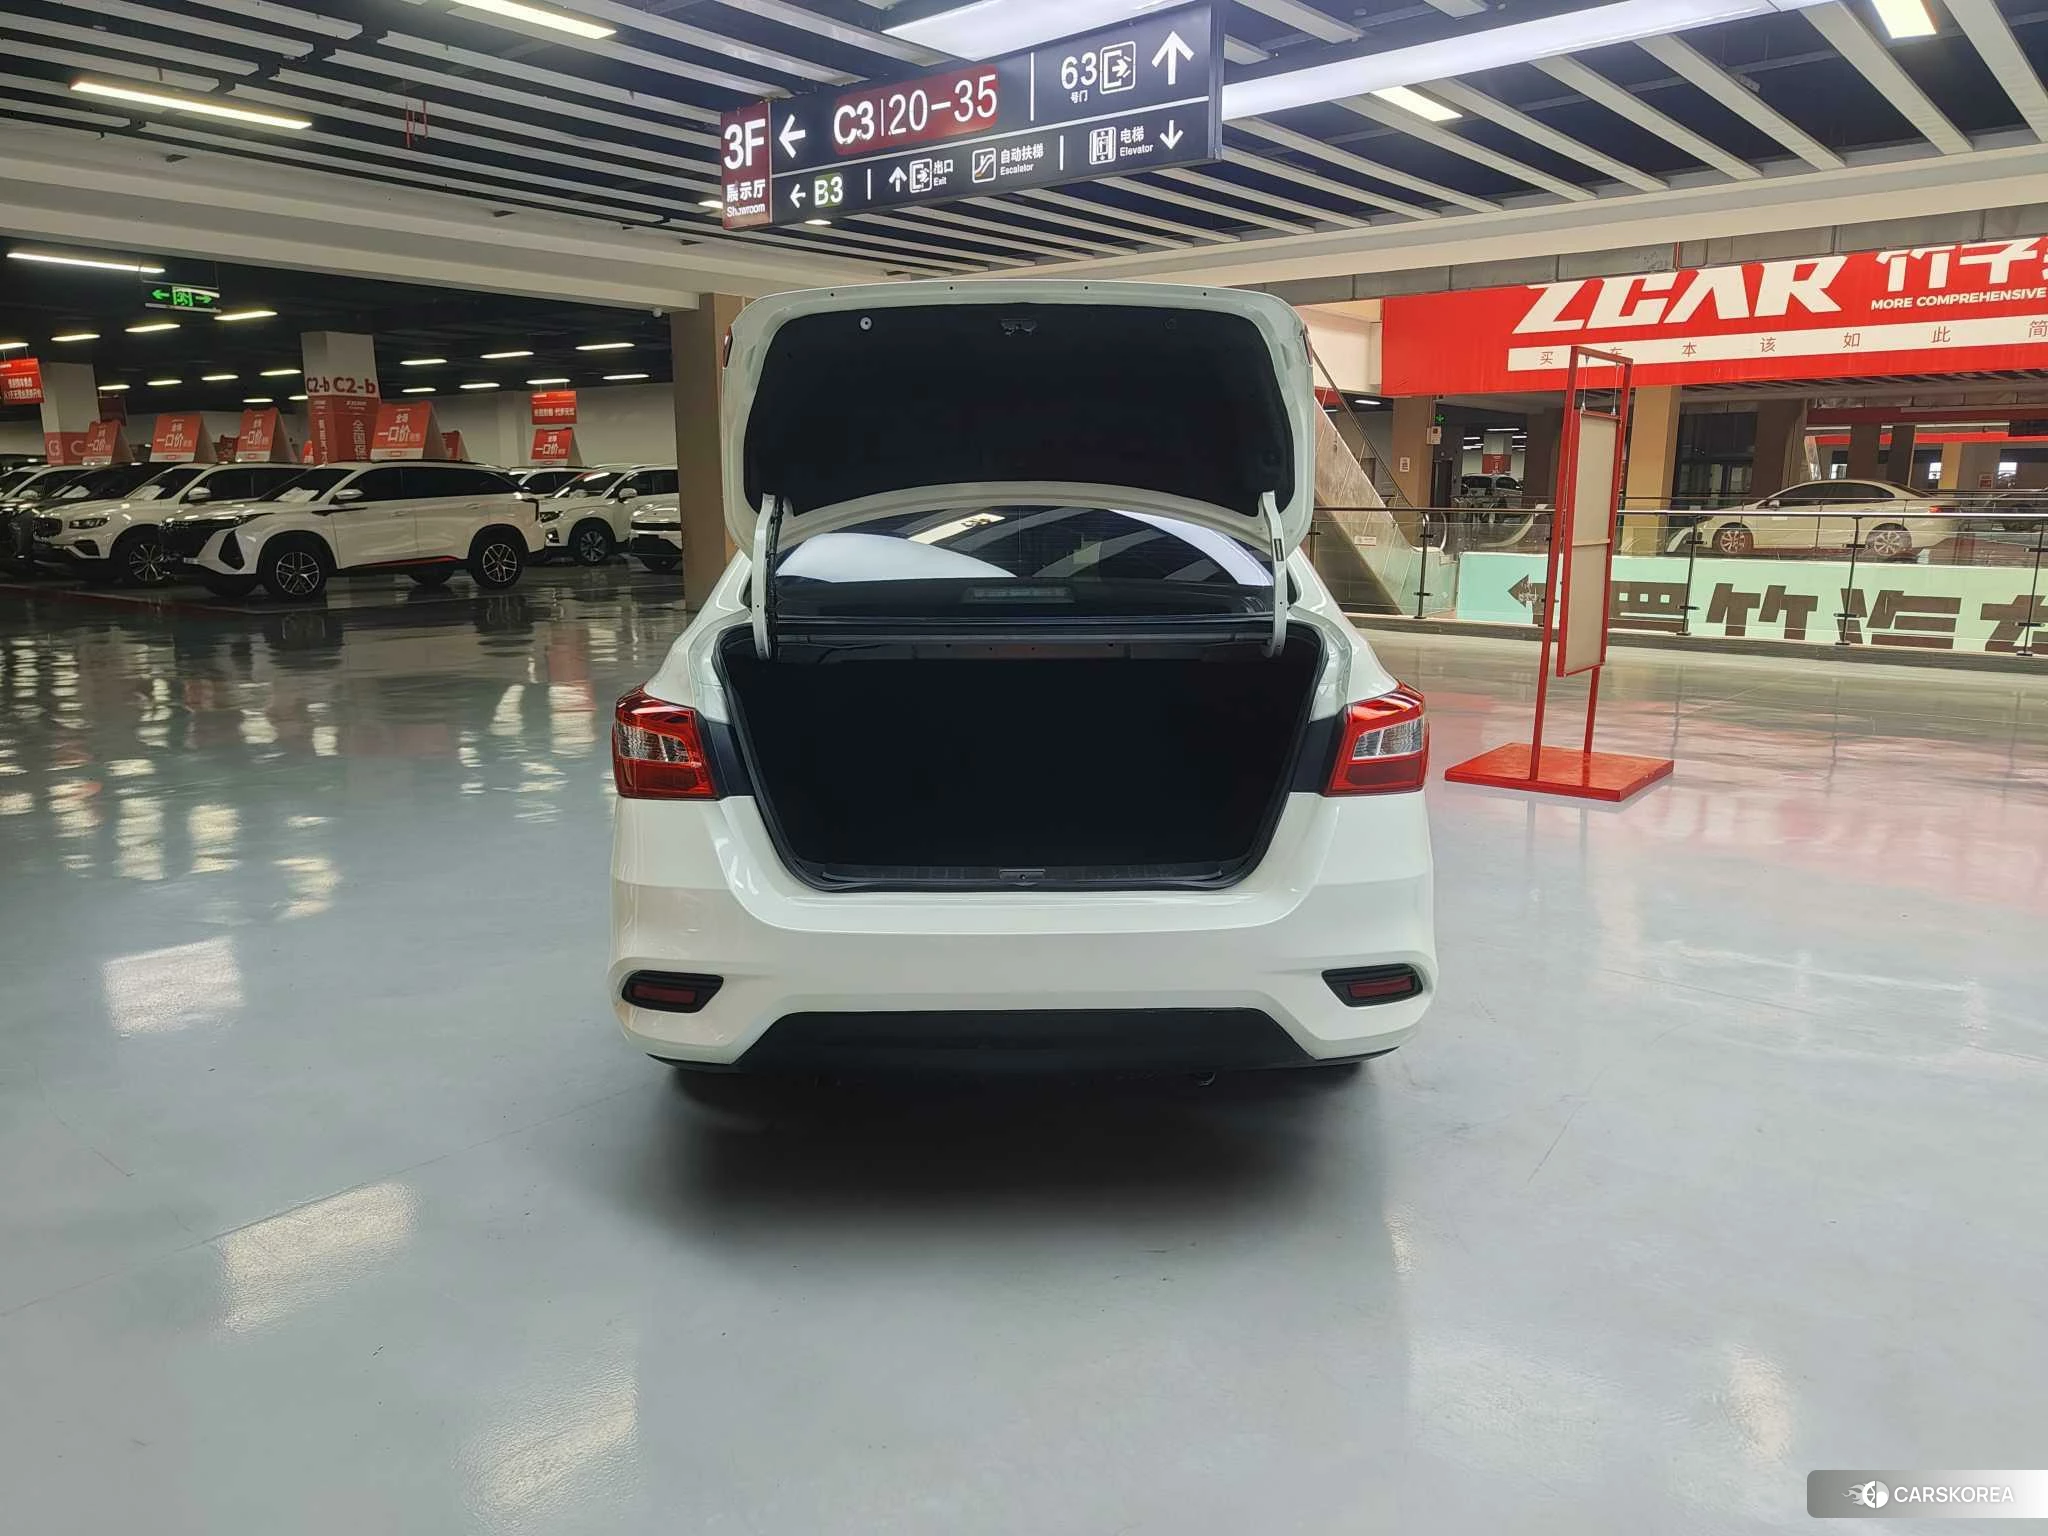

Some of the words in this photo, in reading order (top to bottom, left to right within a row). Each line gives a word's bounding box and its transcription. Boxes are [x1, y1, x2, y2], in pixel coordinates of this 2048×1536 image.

[1061, 52, 1098, 89] 63
[1070, 90, 1088, 103] 号门
[833, 101, 875, 145] C3
[888, 74, 998, 136] 20-35
[1119, 126, 1145, 143] 电梯
[723, 118, 766, 170] 3F
[1119, 143, 1153, 157] Elevator
[1000, 143, 1044, 164] 自动扶梯
[933, 159, 954, 175] 出口
[1000, 163, 1035, 176] Escalator
[726, 179, 766, 202] 展示厅
[933, 177, 947, 187] Exit
[814, 176, 843, 207] B3
[726, 203, 766, 218] Showroom
[1875, 236, 2048, 292] 竹子
[1512, 256, 1847, 334] ZCAR
[1870, 296, 1913, 311] MORE
[1916, 286, 2048, 307] COMPREHENSIVE
[306, 376, 330, 393] C2-b
[333, 376, 376, 394] C2-b
[377, 424, 411, 442] 一口价
